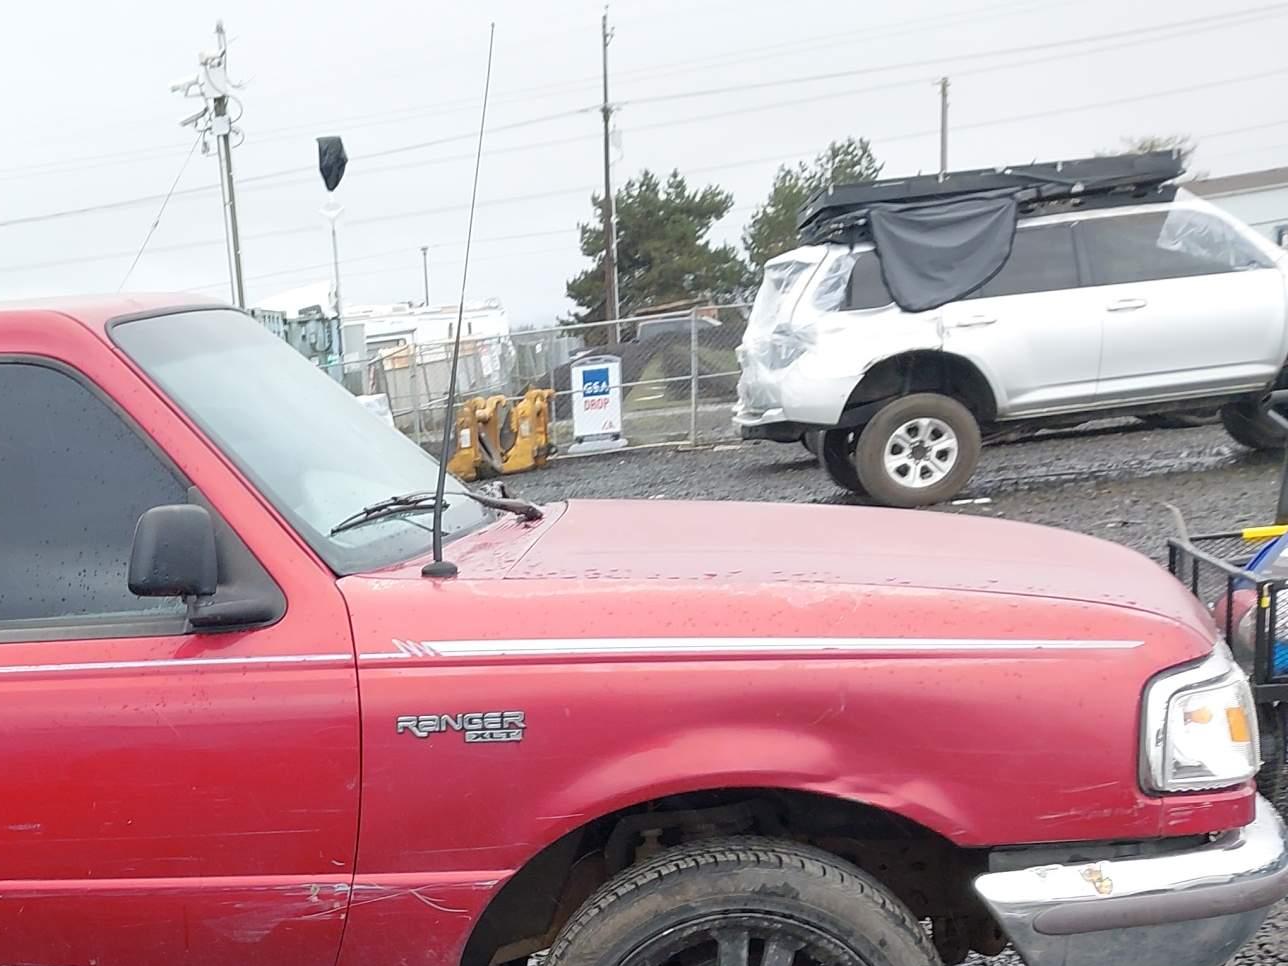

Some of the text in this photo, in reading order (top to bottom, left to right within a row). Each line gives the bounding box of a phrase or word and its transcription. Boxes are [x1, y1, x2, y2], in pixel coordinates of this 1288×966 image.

[583, 398, 610, 411] DROP
[396, 711, 527, 738] RANGER
[469, 730, 520, 742] XLT
